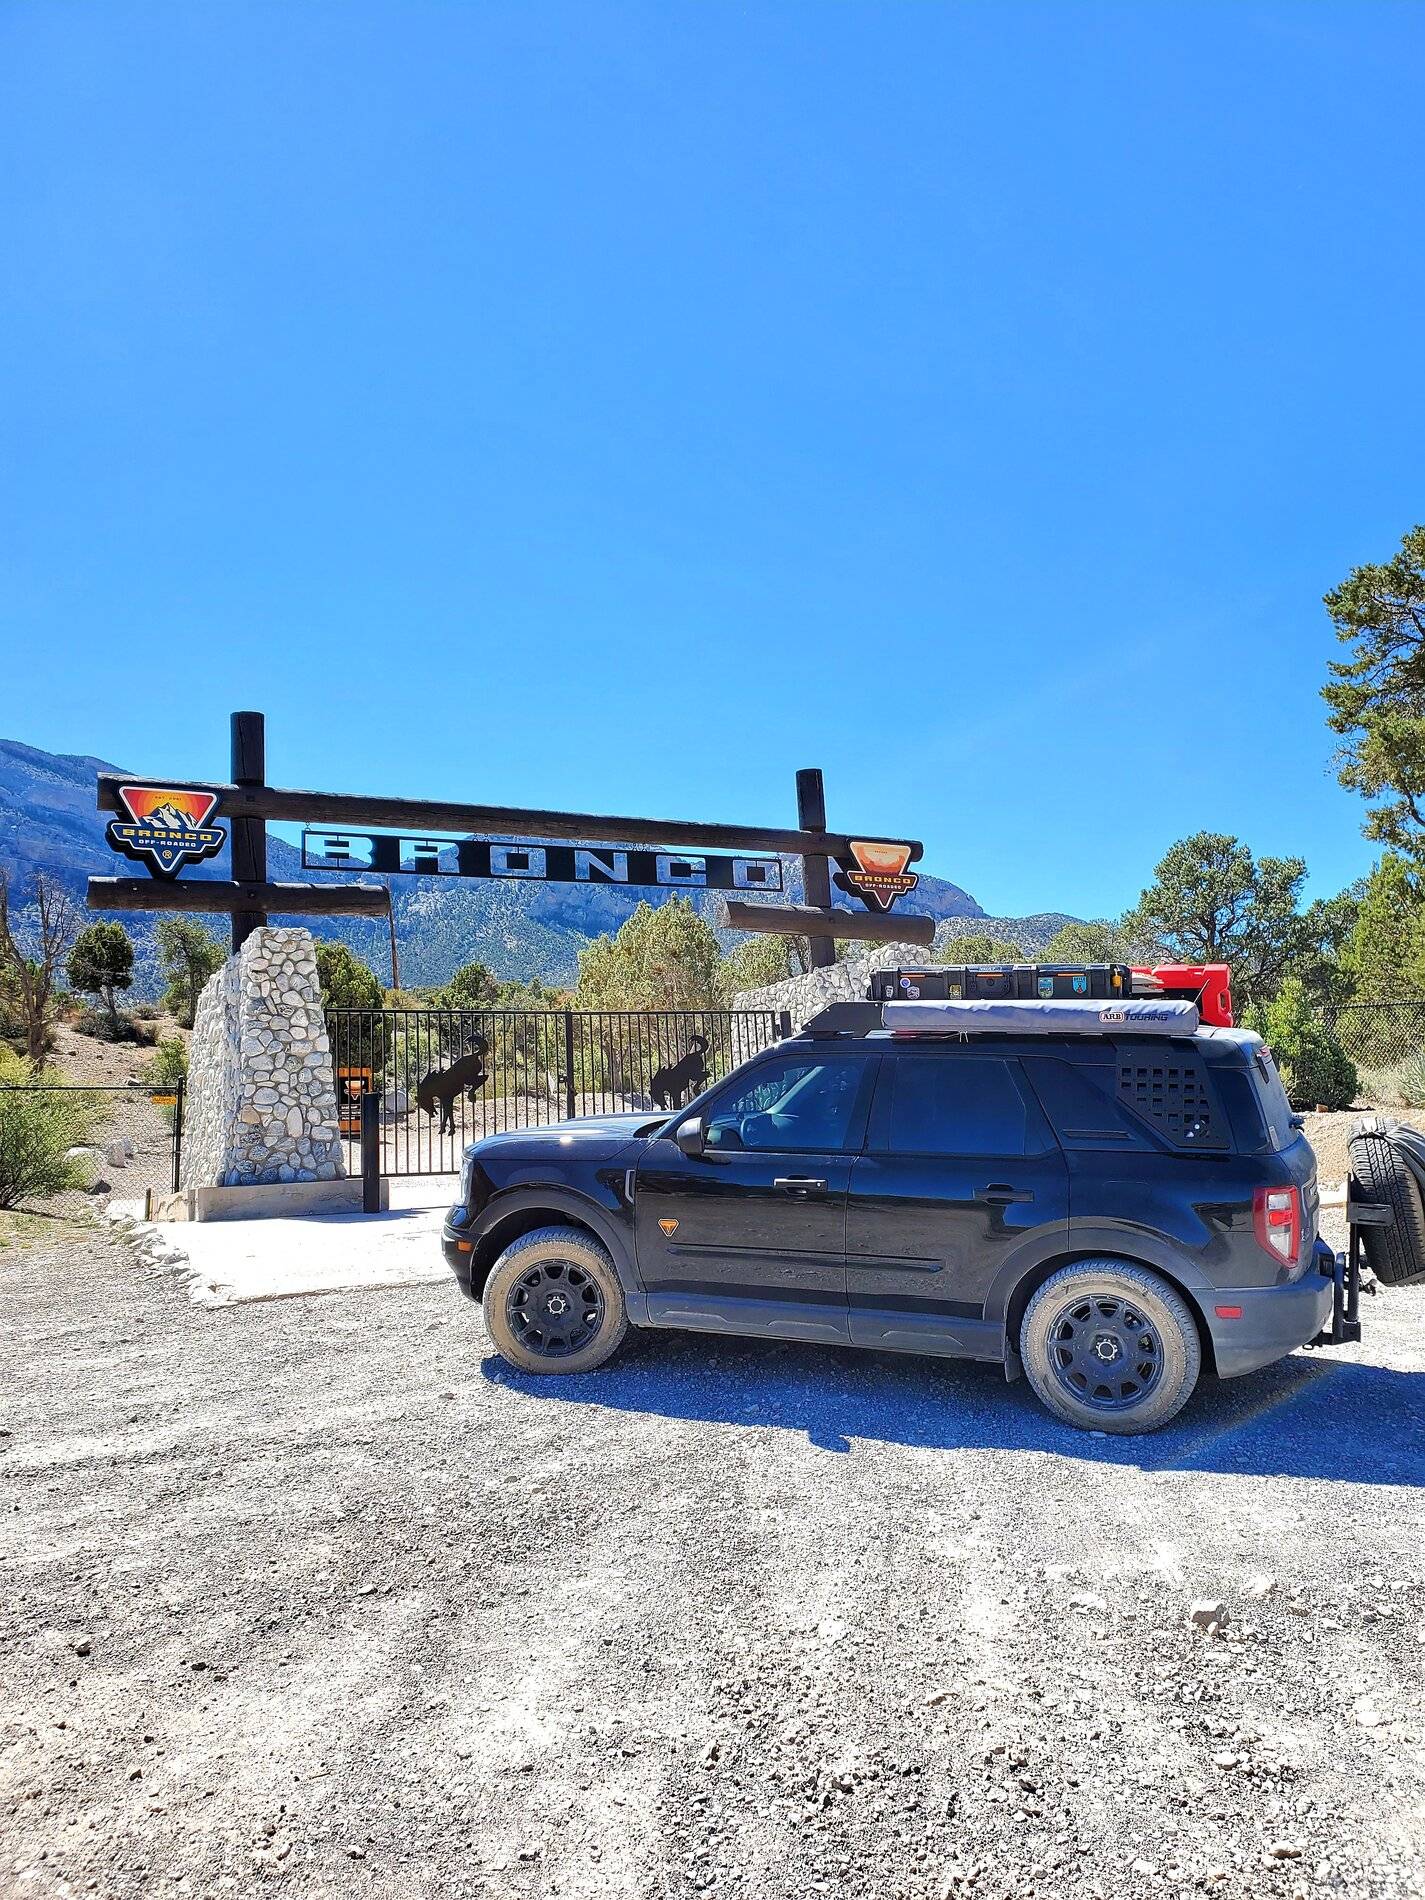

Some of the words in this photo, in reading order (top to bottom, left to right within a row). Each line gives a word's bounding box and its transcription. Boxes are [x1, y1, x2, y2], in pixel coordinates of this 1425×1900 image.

[122, 828, 212, 841] BRONCO
[305, 834, 781, 888] BRONCO
[854, 875, 911, 884] BRONCO
[1125, 1013, 1169, 1021] TOURING
